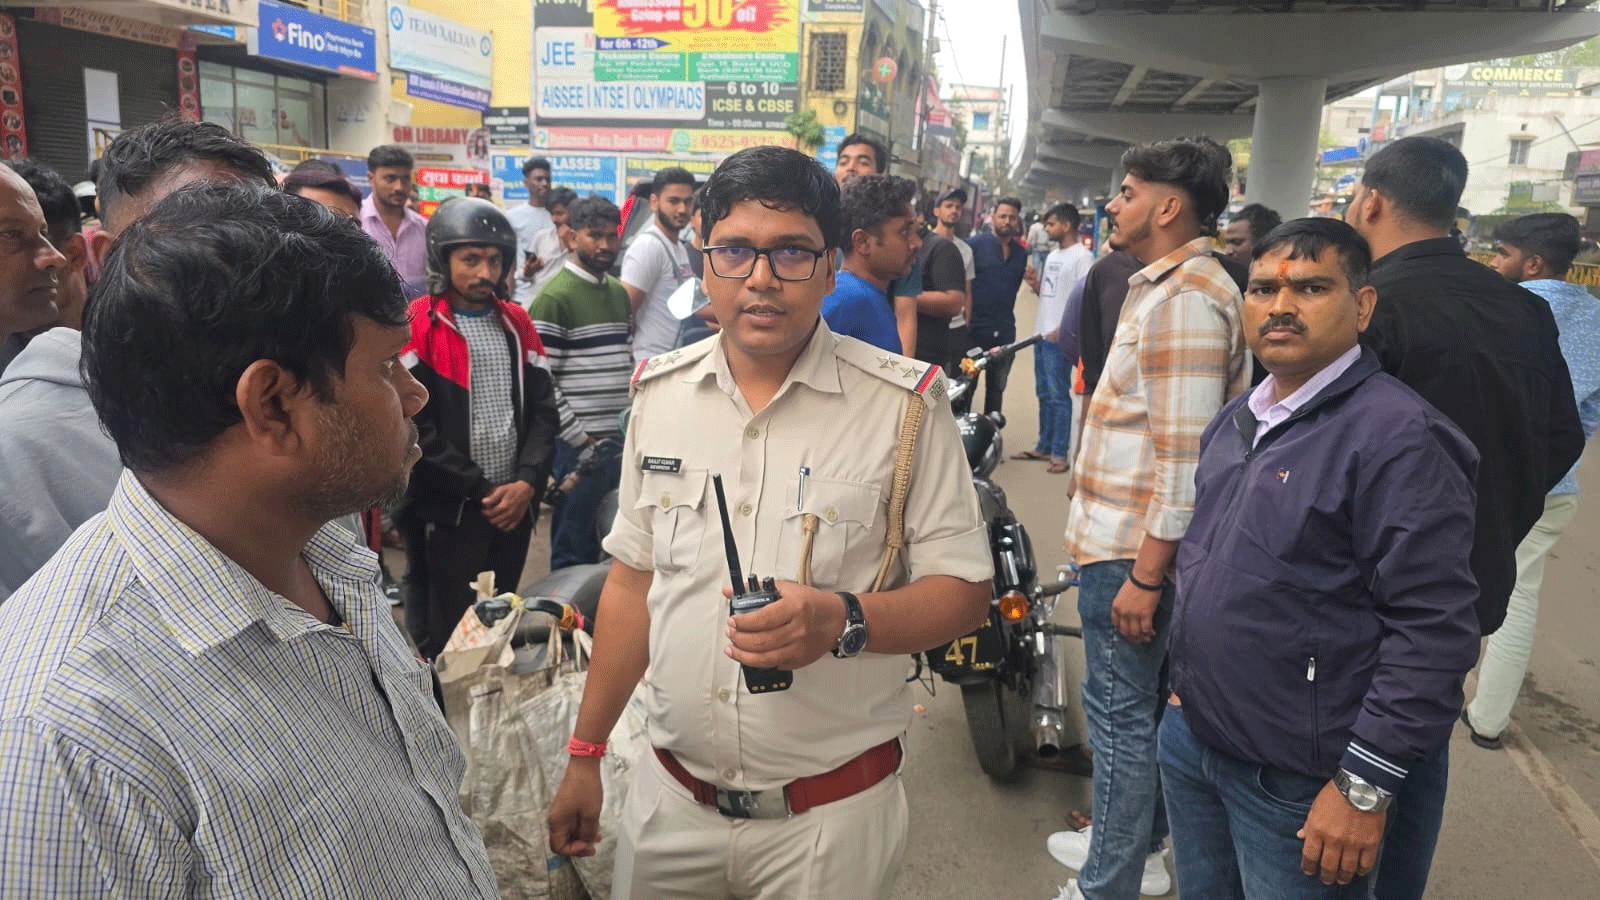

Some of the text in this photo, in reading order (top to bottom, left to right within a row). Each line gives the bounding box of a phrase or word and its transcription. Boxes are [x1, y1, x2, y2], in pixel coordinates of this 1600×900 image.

[408, 16, 438, 38] TEAM
[287, 22, 325, 52] Fino
[600, 39, 614, 49] for
[541, 42, 576, 66] JEE
[1471, 67, 1564, 82] COMMERCE
[727, 81, 779, 96] 6 to 10
[542, 85, 702, 110] AISSEE NTSE OLYMPIADS
[712, 98, 794, 113] ICSE & CBSE
[416, 127, 470, 144] LIBRARY
[546, 157, 601, 171] LASSES
[738, 597, 770, 605] MOTOROLA
[945, 636, 978, 666] 47
